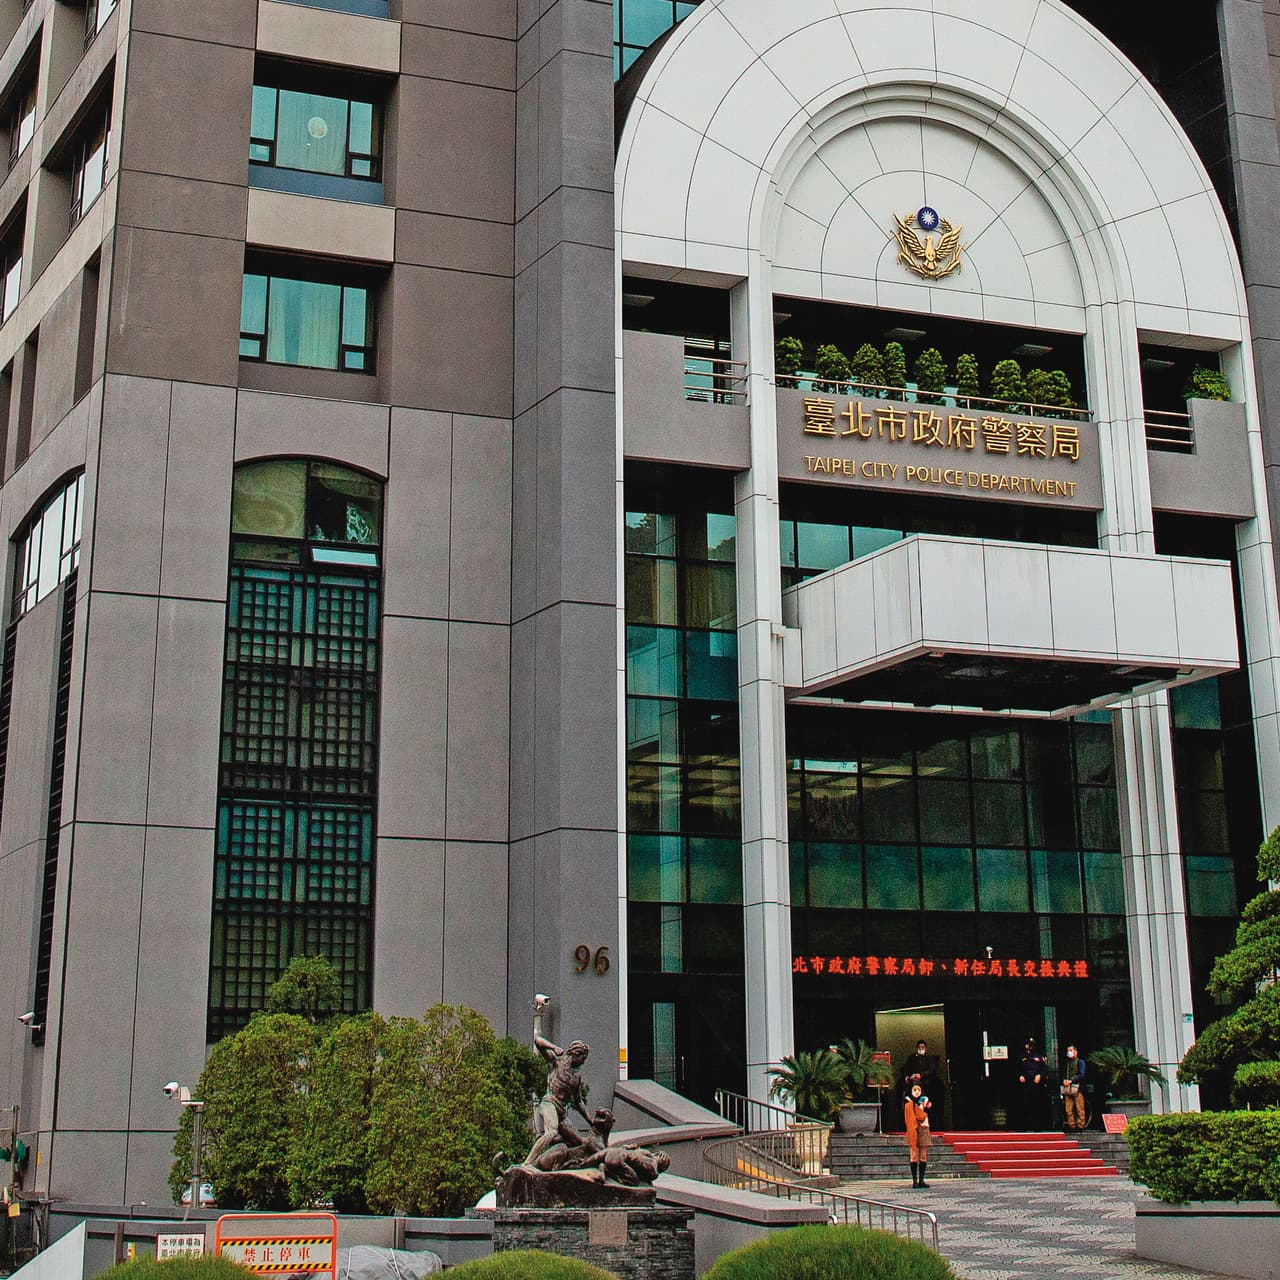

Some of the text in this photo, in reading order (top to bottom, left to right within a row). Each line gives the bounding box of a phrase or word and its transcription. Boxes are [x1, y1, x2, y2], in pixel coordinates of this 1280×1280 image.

[803, 397, 1081, 462] 臺北市政府警察局
[805, 455, 1077, 498] TAIPEI CITY POLICE DEPARTMENT
[575, 944, 610, 976] 96
[243, 1246, 312, 1263] 禁止停車
